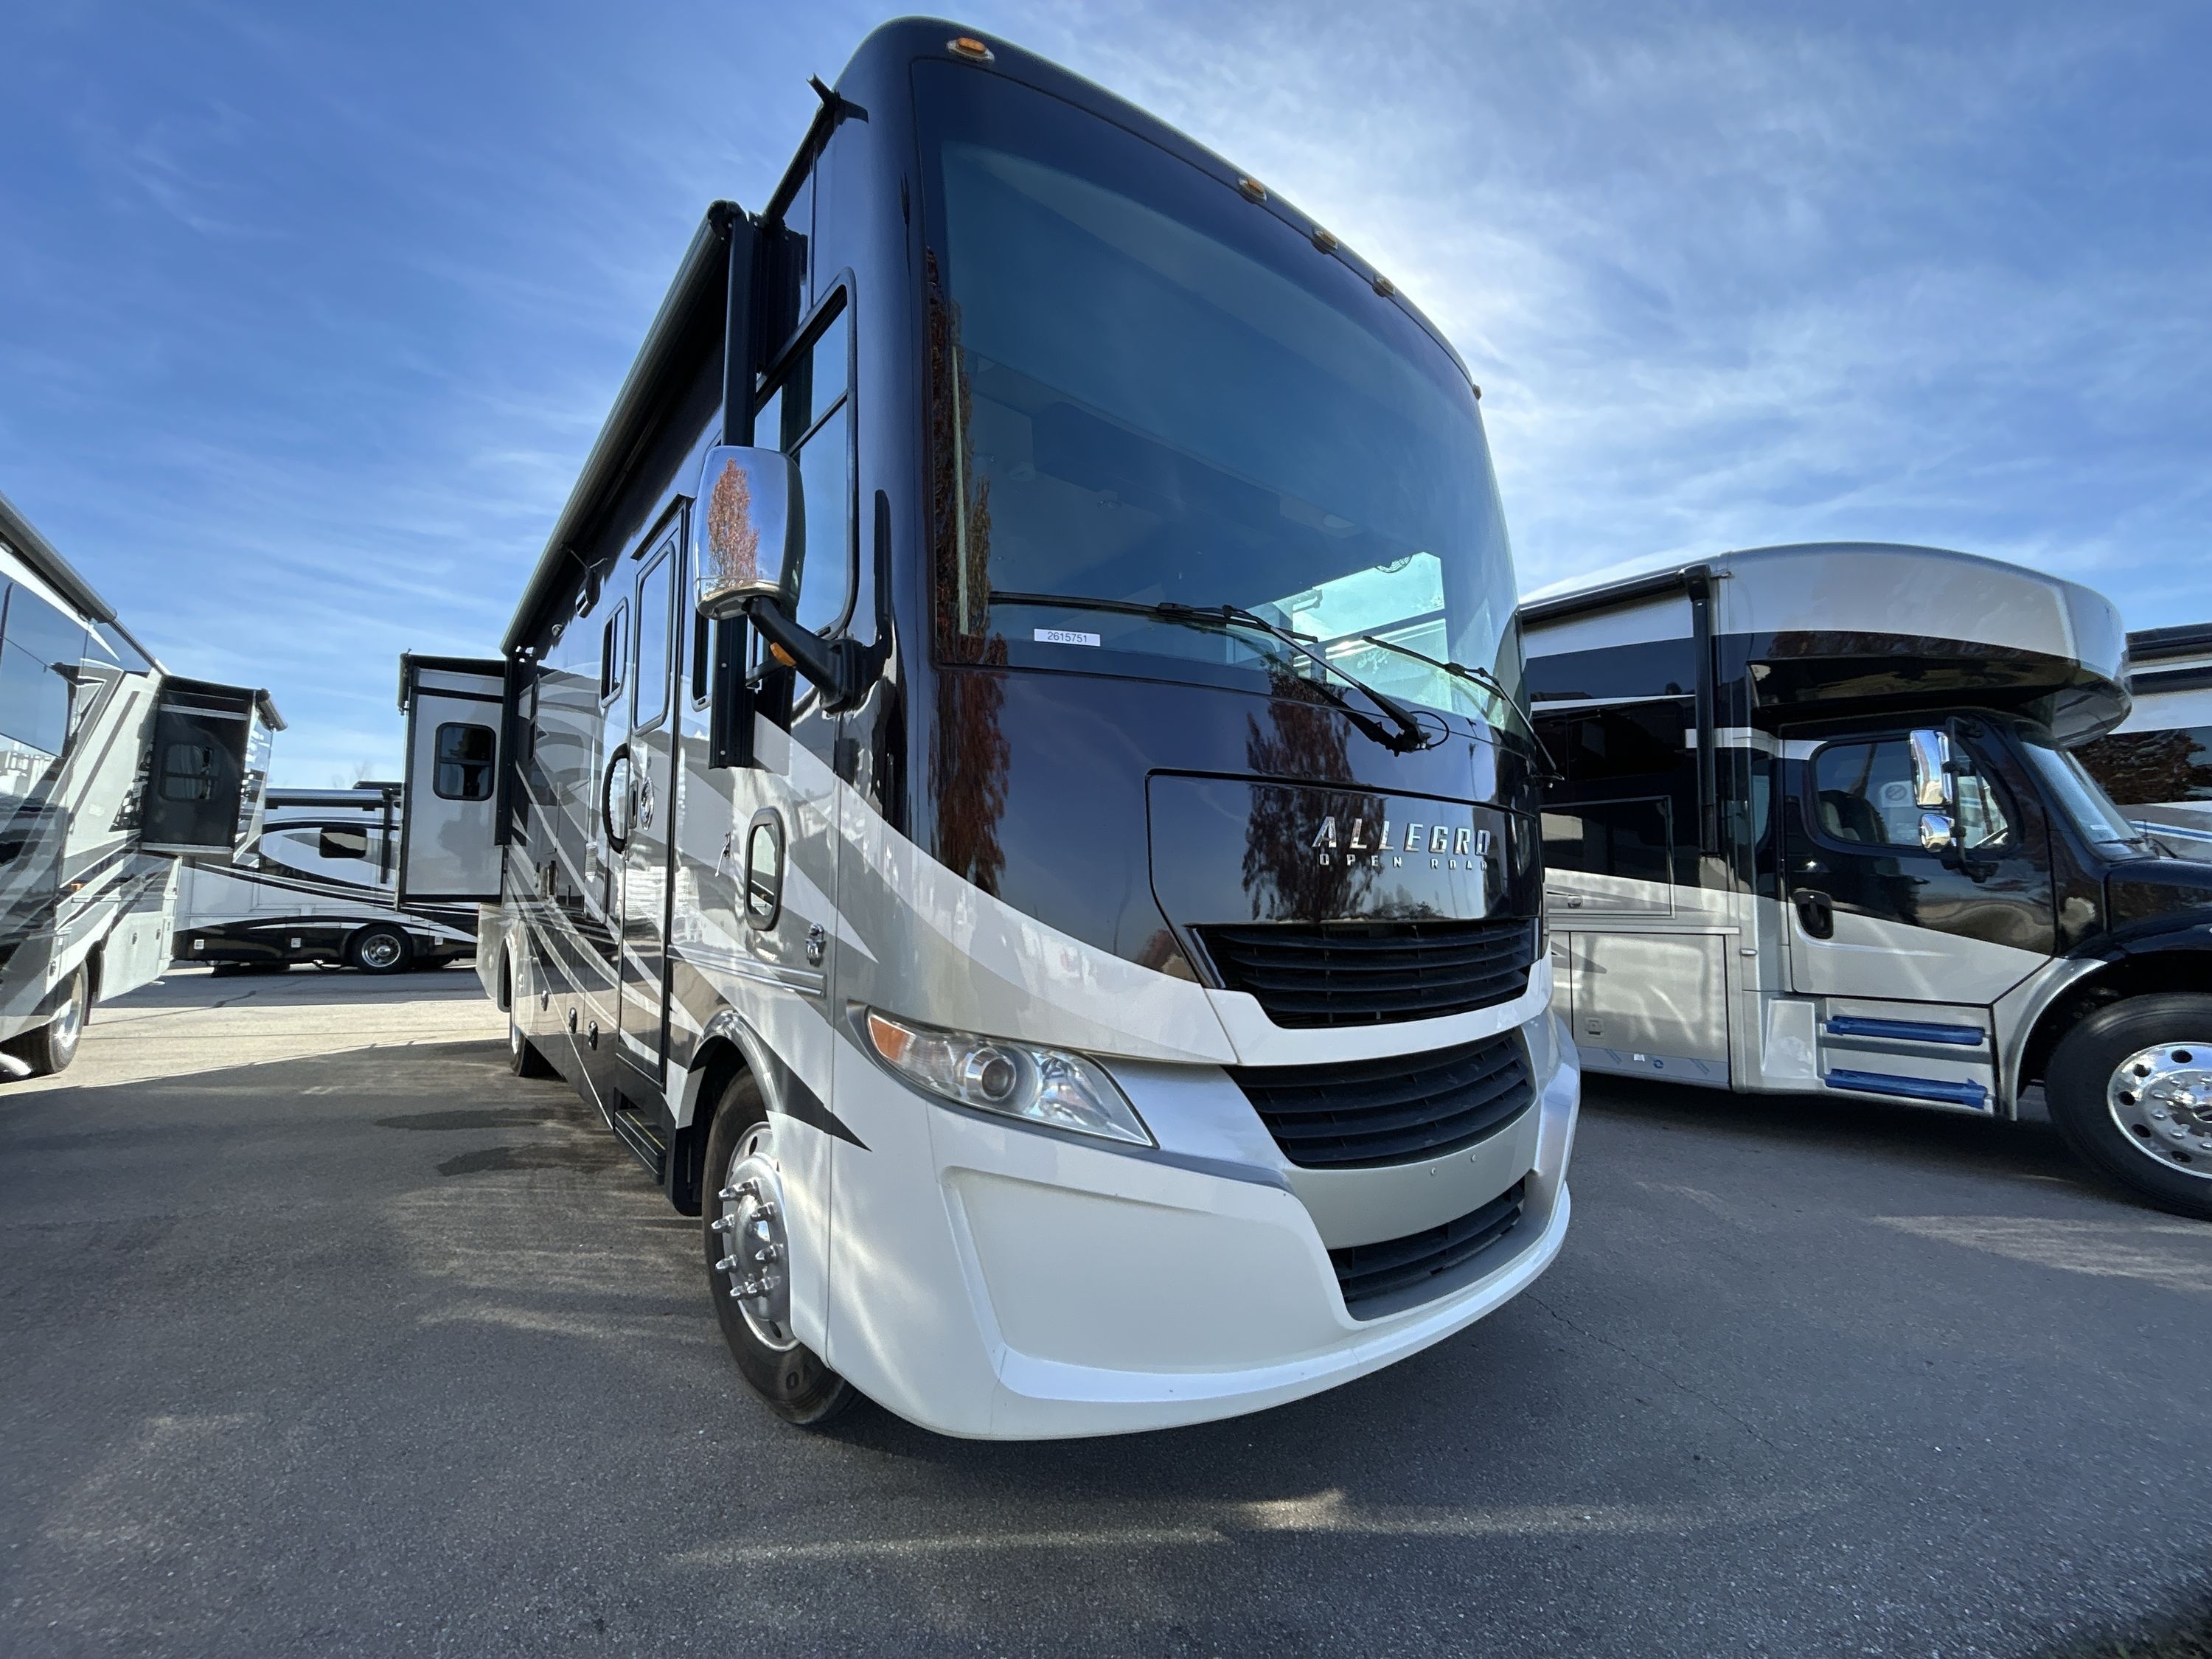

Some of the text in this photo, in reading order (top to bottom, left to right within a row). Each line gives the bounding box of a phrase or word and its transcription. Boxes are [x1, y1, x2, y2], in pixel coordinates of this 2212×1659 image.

[1047, 631, 1088, 643] 2615751
[1312, 816, 1490, 855] ALLEGRO
[1319, 853, 1488, 871] OPEN ROAD
